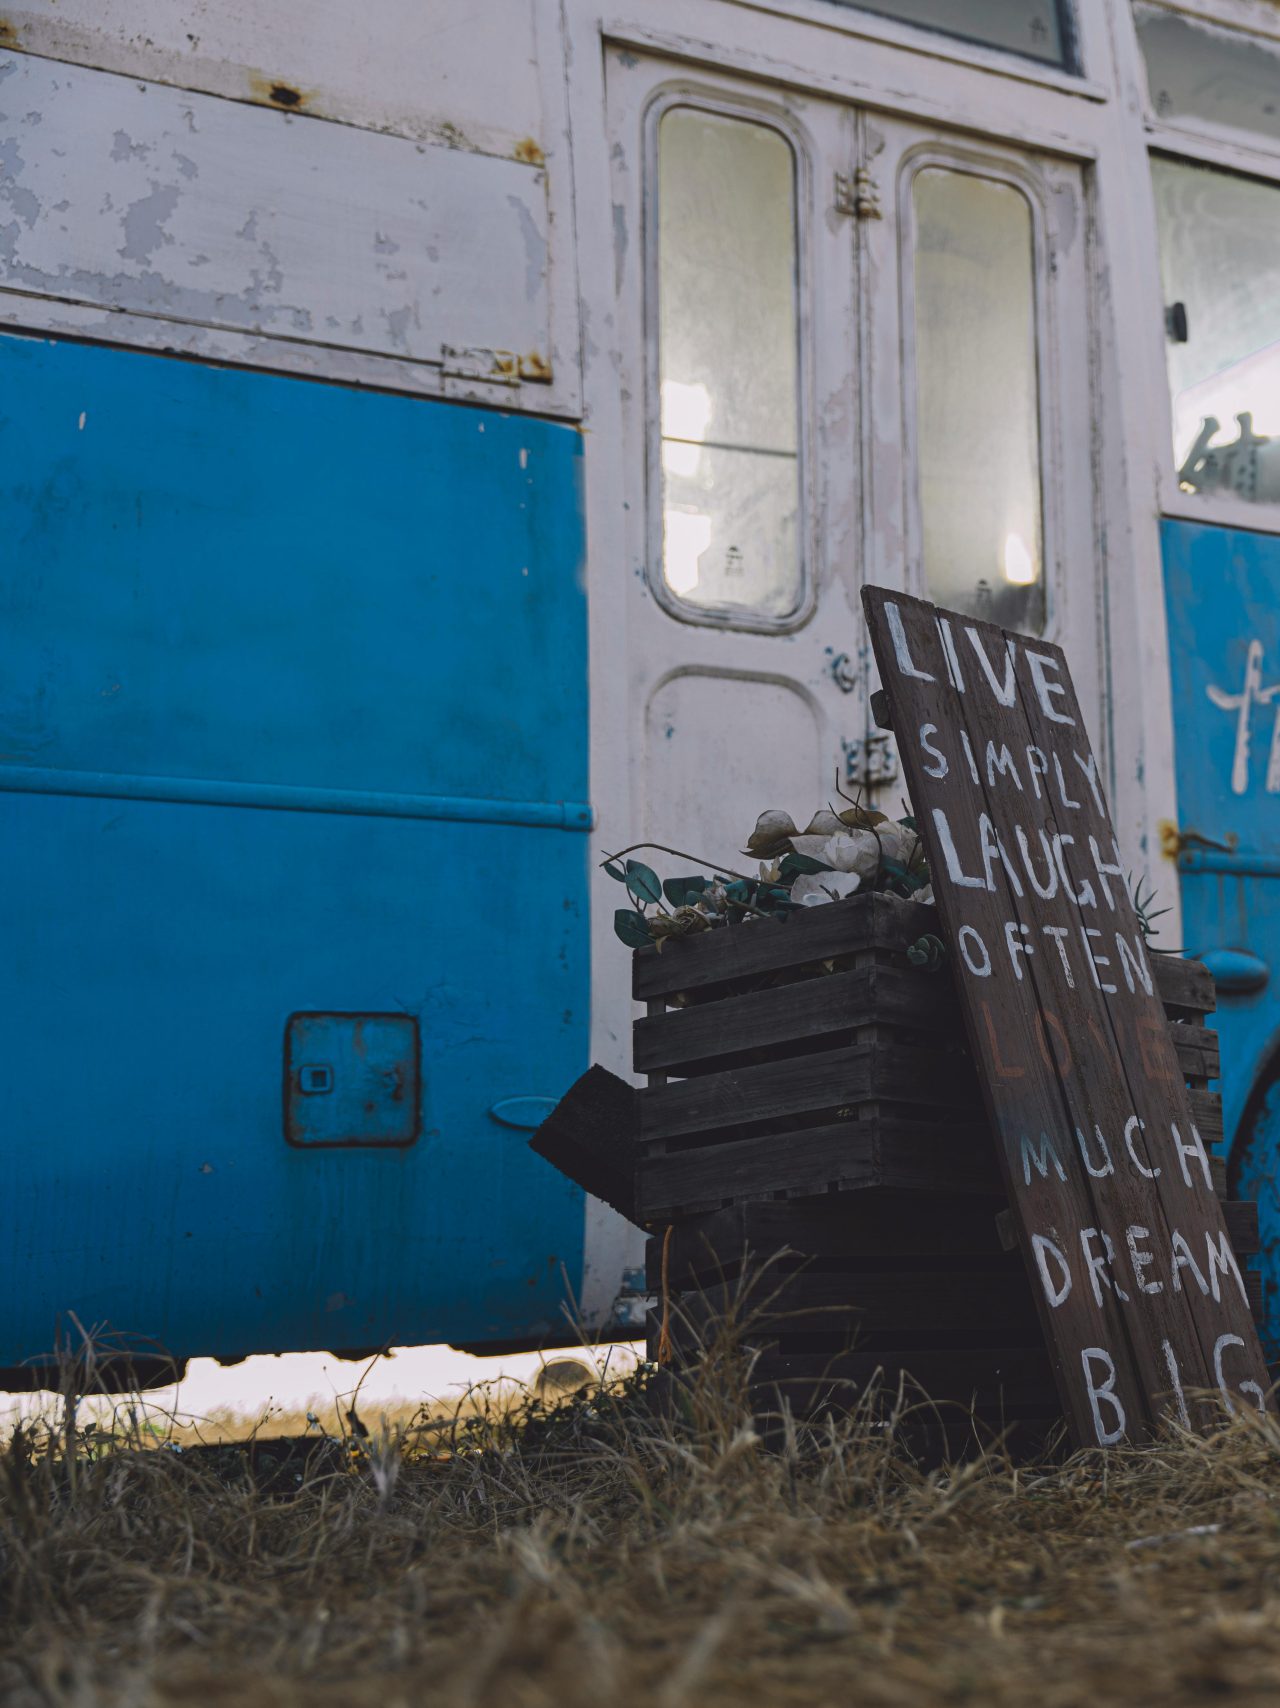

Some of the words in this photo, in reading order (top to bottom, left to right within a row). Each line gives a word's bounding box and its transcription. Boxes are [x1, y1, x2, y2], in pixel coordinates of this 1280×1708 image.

[883, 601, 1076, 726] LIVE
[920, 723, 1105, 818] SIMPLY
[931, 808, 1138, 913] LAUGH
[957, 921, 1154, 997] OFTEN
[980, 1000, 1175, 1079] LOVE
[1020, 1115, 1213, 1191] MUCH
[1031, 1224, 1250, 1309] DREAM
[1081, 1333, 1266, 1447] BIG
